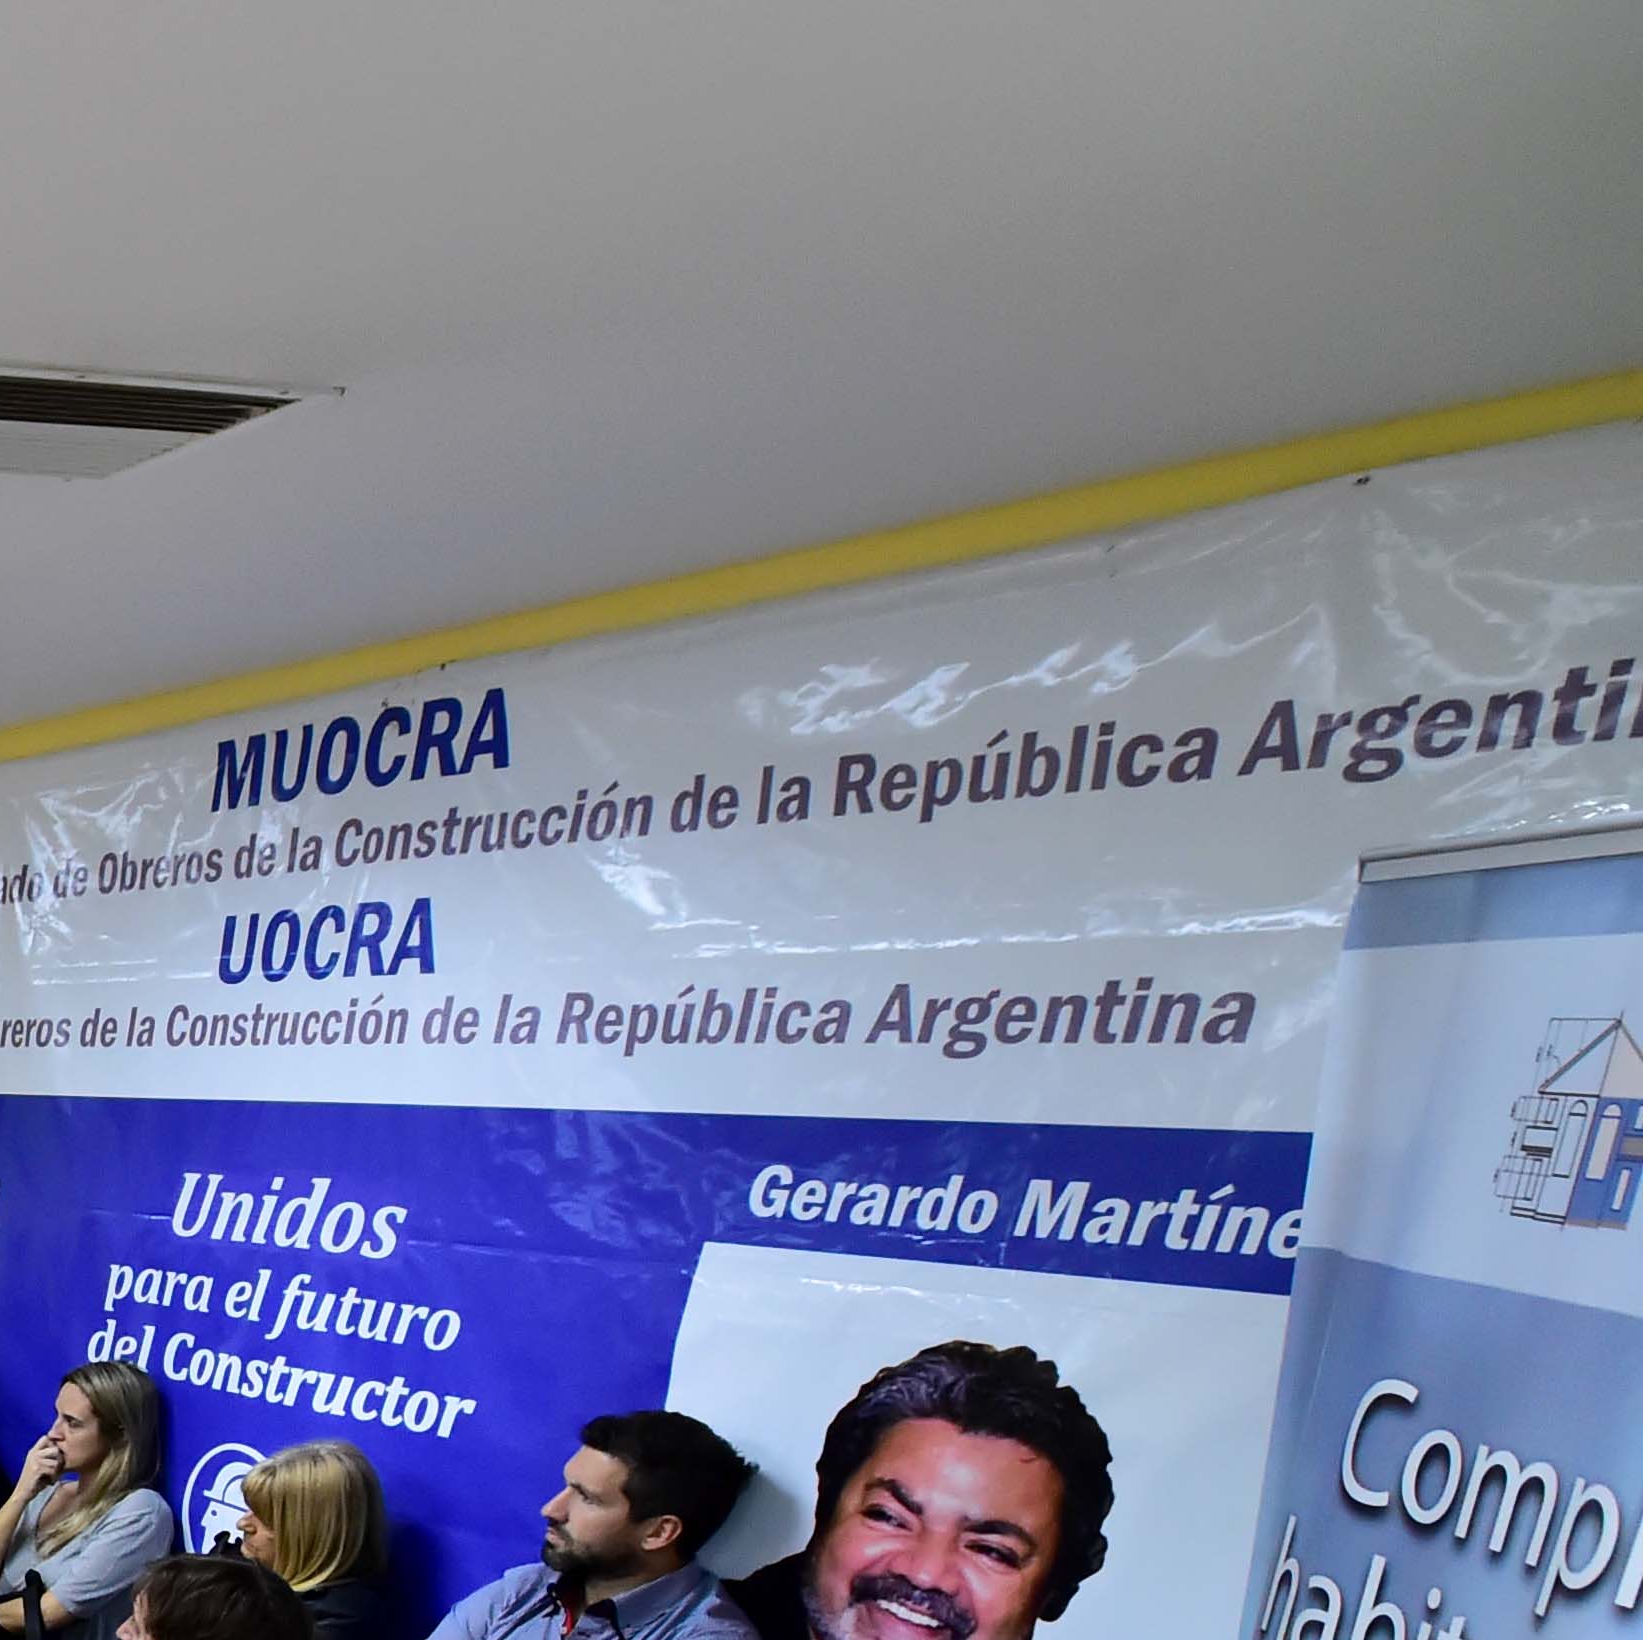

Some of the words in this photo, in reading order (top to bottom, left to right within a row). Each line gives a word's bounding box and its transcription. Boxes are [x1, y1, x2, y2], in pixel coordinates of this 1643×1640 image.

[53, 861, 89, 899] de
[97, 847, 223, 892] Obreros
[234, 835, 277, 880] de
[288, 829, 322, 873] la
[334, 780, 653, 865] Construcción
[670, 774, 739, 833] de
[757, 765, 812, 823] la
[833, 720, 1221, 823] República
[1238, 657, 1643, 784] Argenti
[211, 688, 511, 814] MUOCRA
[217, 897, 436, 985] UOCRA
[78, 1006, 119, 1049] de
[126, 1006, 156, 1048] la
[165, 993, 410, 1049] Construcción
[421, 996, 480, 1046] de
[493, 994, 539, 1046] la
[556, 980, 850, 1058] República
[866, 976, 1256, 1060] Argentina
[170, 1171, 408, 1262] Unidos
[746, 1162, 999, 1235] Gerardo
[104, 1262, 214, 1314] para
[224, 1269, 271, 1322] el
[265, 1273, 462, 1352] futuro
[87, 1318, 156, 1373] del
[163, 1332, 477, 1440] Constructor
